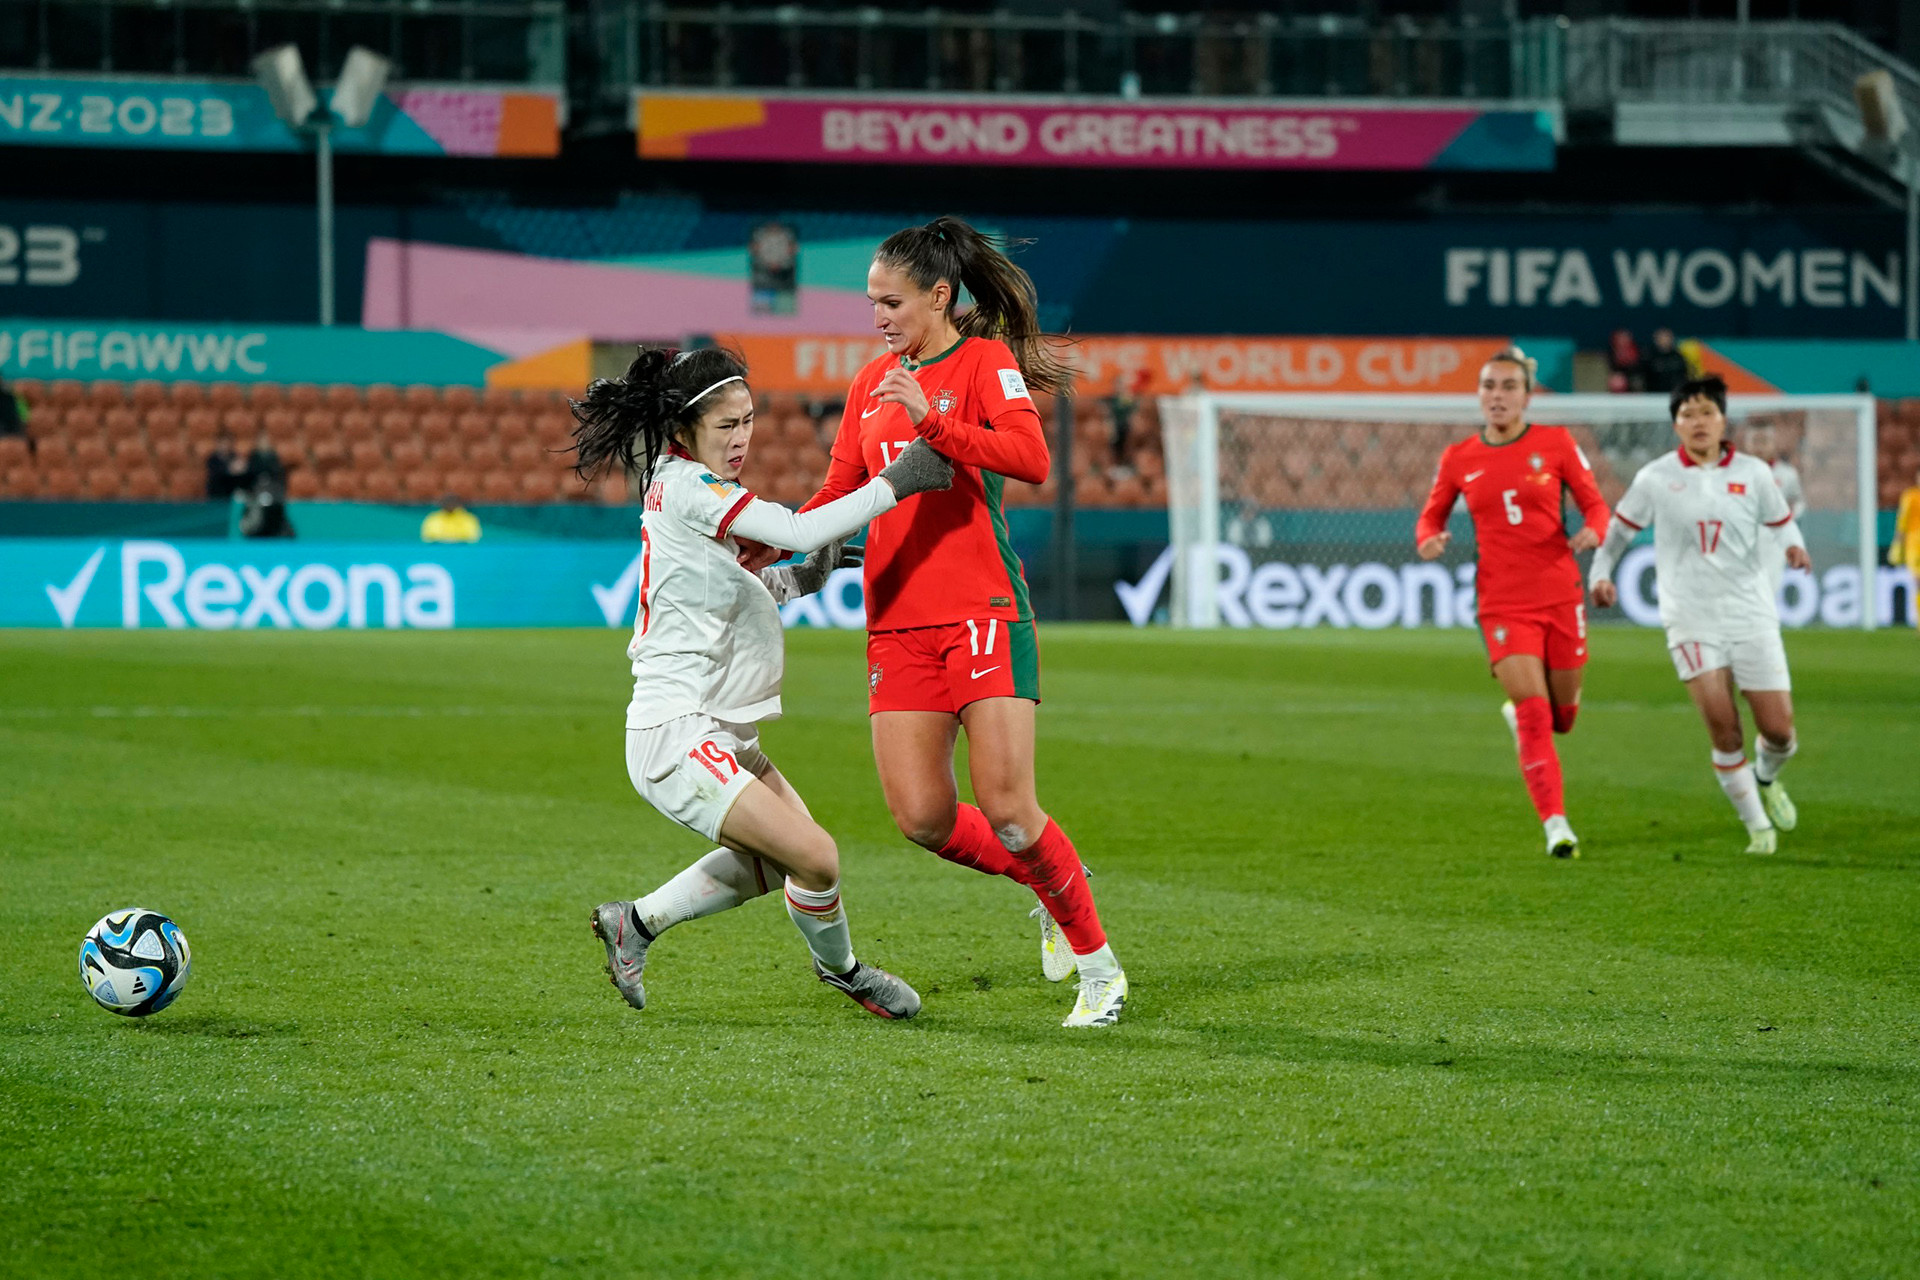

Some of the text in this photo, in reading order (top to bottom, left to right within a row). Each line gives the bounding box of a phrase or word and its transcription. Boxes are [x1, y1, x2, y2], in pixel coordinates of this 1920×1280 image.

[822, 110, 1028, 155] BEYOND
[1445, 249, 1899, 307] FIFA WOMEN
[796, 342, 880, 380] FIF
[1160, 343, 1344, 386] WORLD
[1503, 489, 1523, 526] 5
[1697, 520, 1722, 553] 17
[121, 540, 455, 629] Rexona
[688, 740, 739, 785] 19
